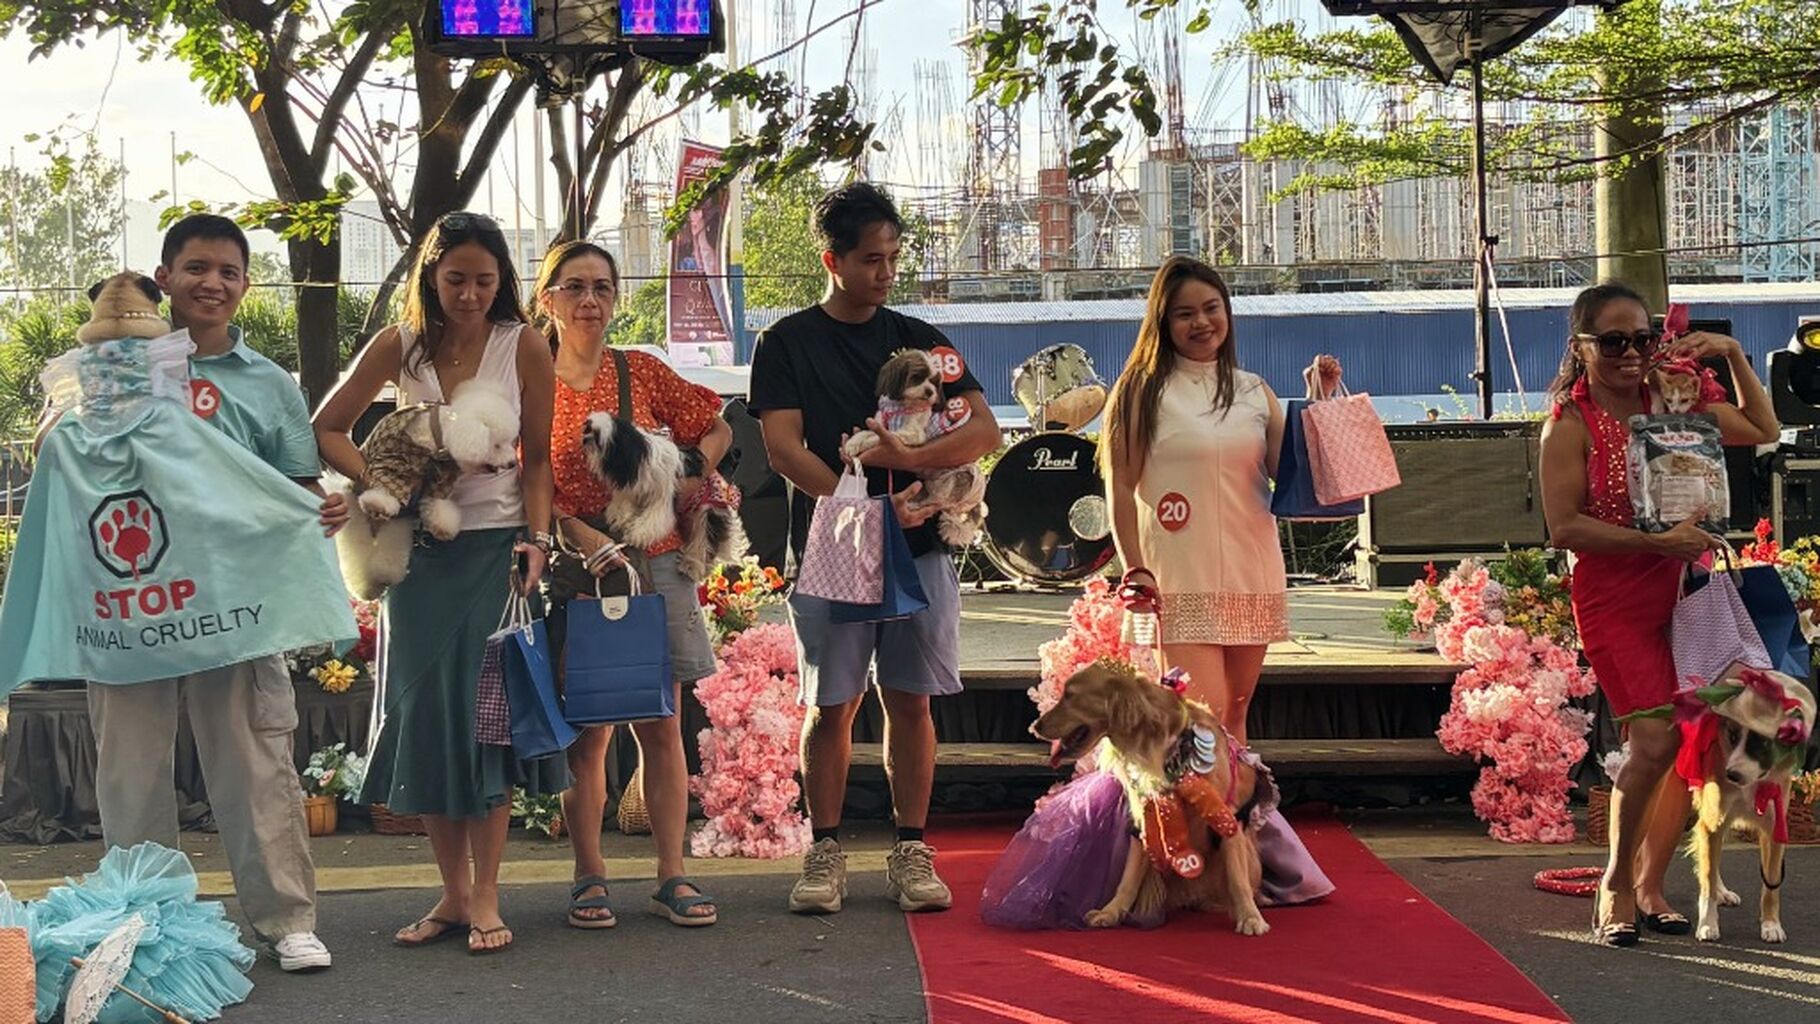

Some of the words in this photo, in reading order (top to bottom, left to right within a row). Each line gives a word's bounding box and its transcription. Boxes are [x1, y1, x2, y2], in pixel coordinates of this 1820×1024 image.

[1027, 447, 1079, 470] Pearl
[1161, 501, 1187, 522] 20
[95, 579, 196, 619] STOP
[76, 625, 132, 650] ANIMAL
[140, 604, 262, 647] CRUELTY
[1176, 854, 1200, 873] 20
